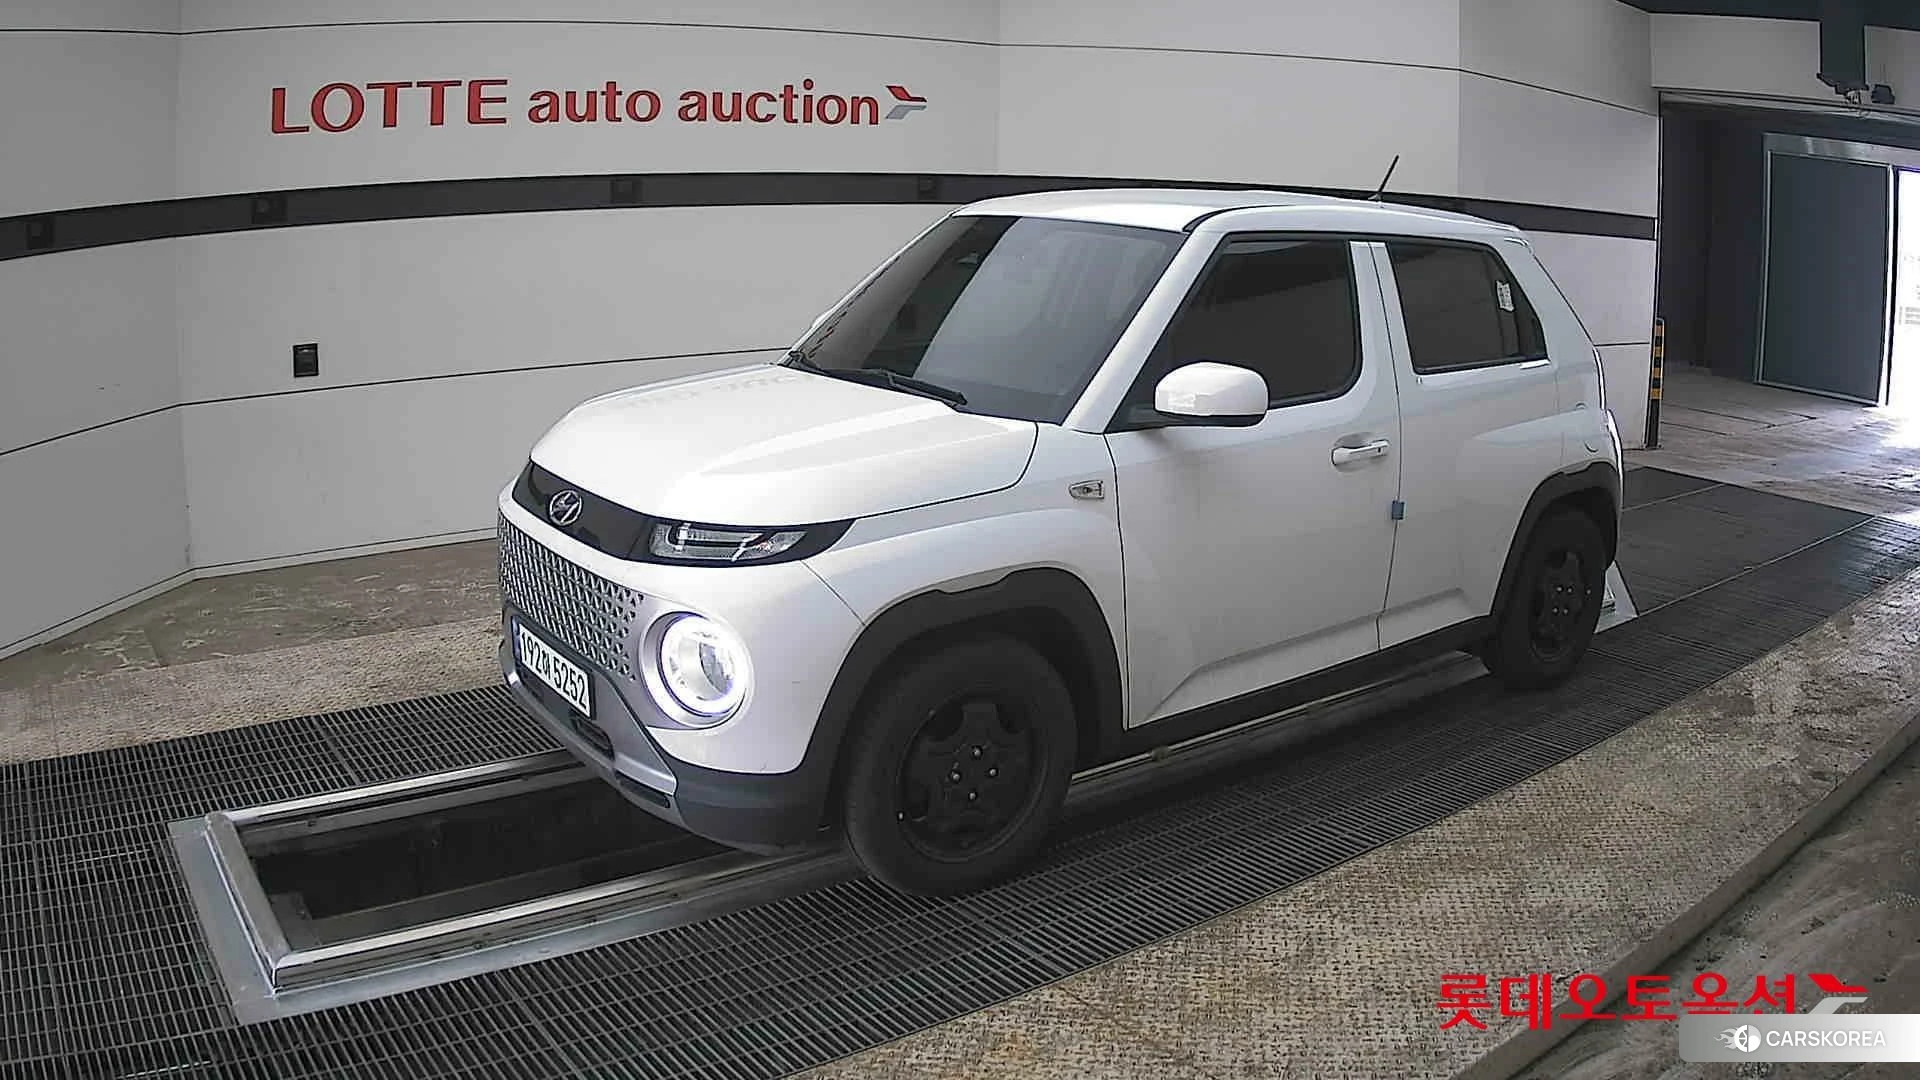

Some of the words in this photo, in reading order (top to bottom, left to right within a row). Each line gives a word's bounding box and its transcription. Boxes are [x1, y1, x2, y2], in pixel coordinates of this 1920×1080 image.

[272, 79, 508, 134] LOTTE
[528, 81, 661, 123] auto
[678, 78, 879, 125] auction
[553, 656, 587, 710] 5252
